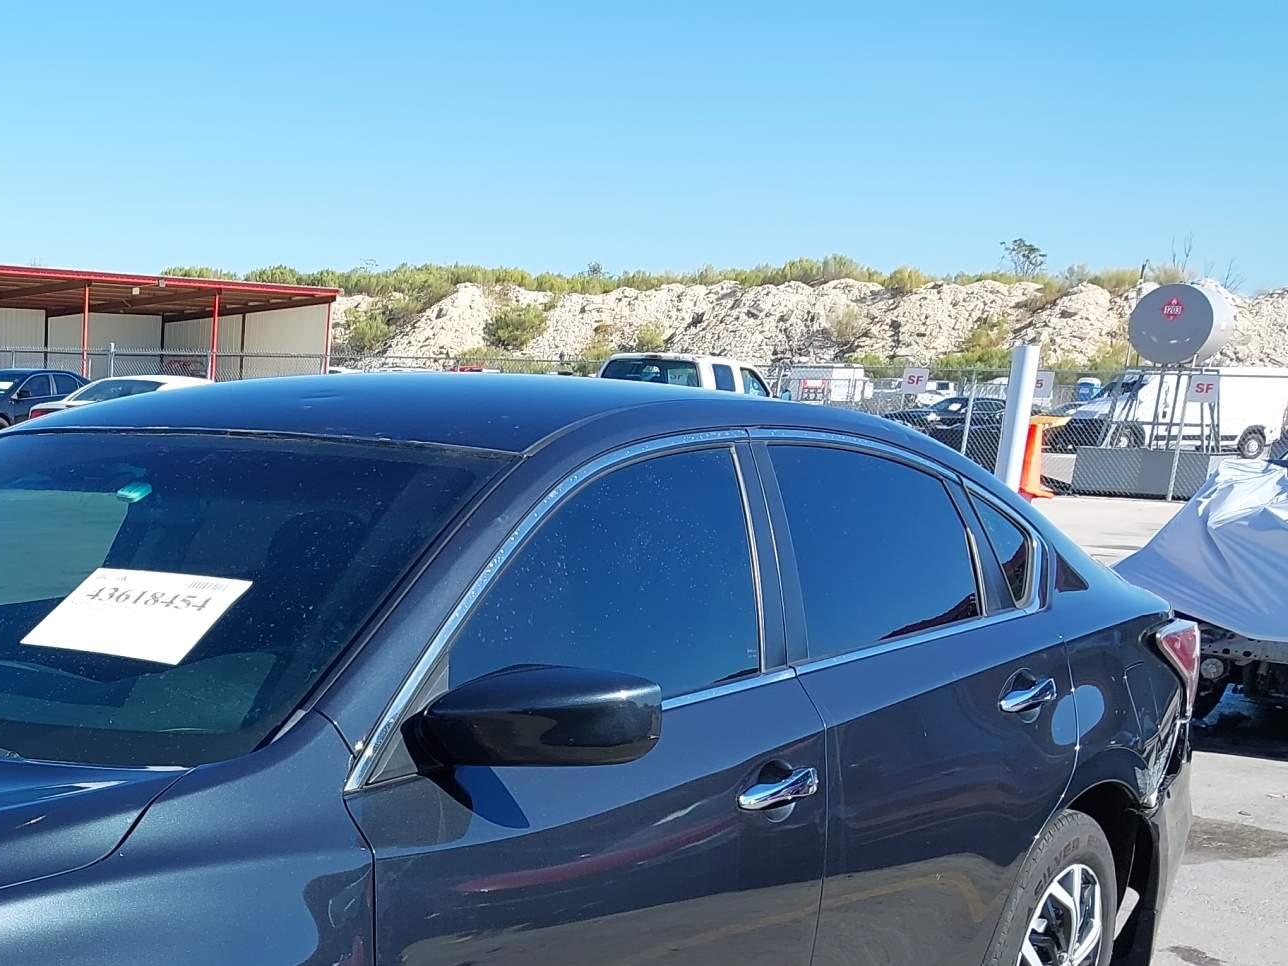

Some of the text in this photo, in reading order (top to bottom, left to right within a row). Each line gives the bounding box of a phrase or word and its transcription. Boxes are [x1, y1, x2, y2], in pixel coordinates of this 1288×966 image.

[906, 374, 924, 385] SF
[1195, 382, 1215, 394] SF
[86, 586, 212, 612] 43618454
